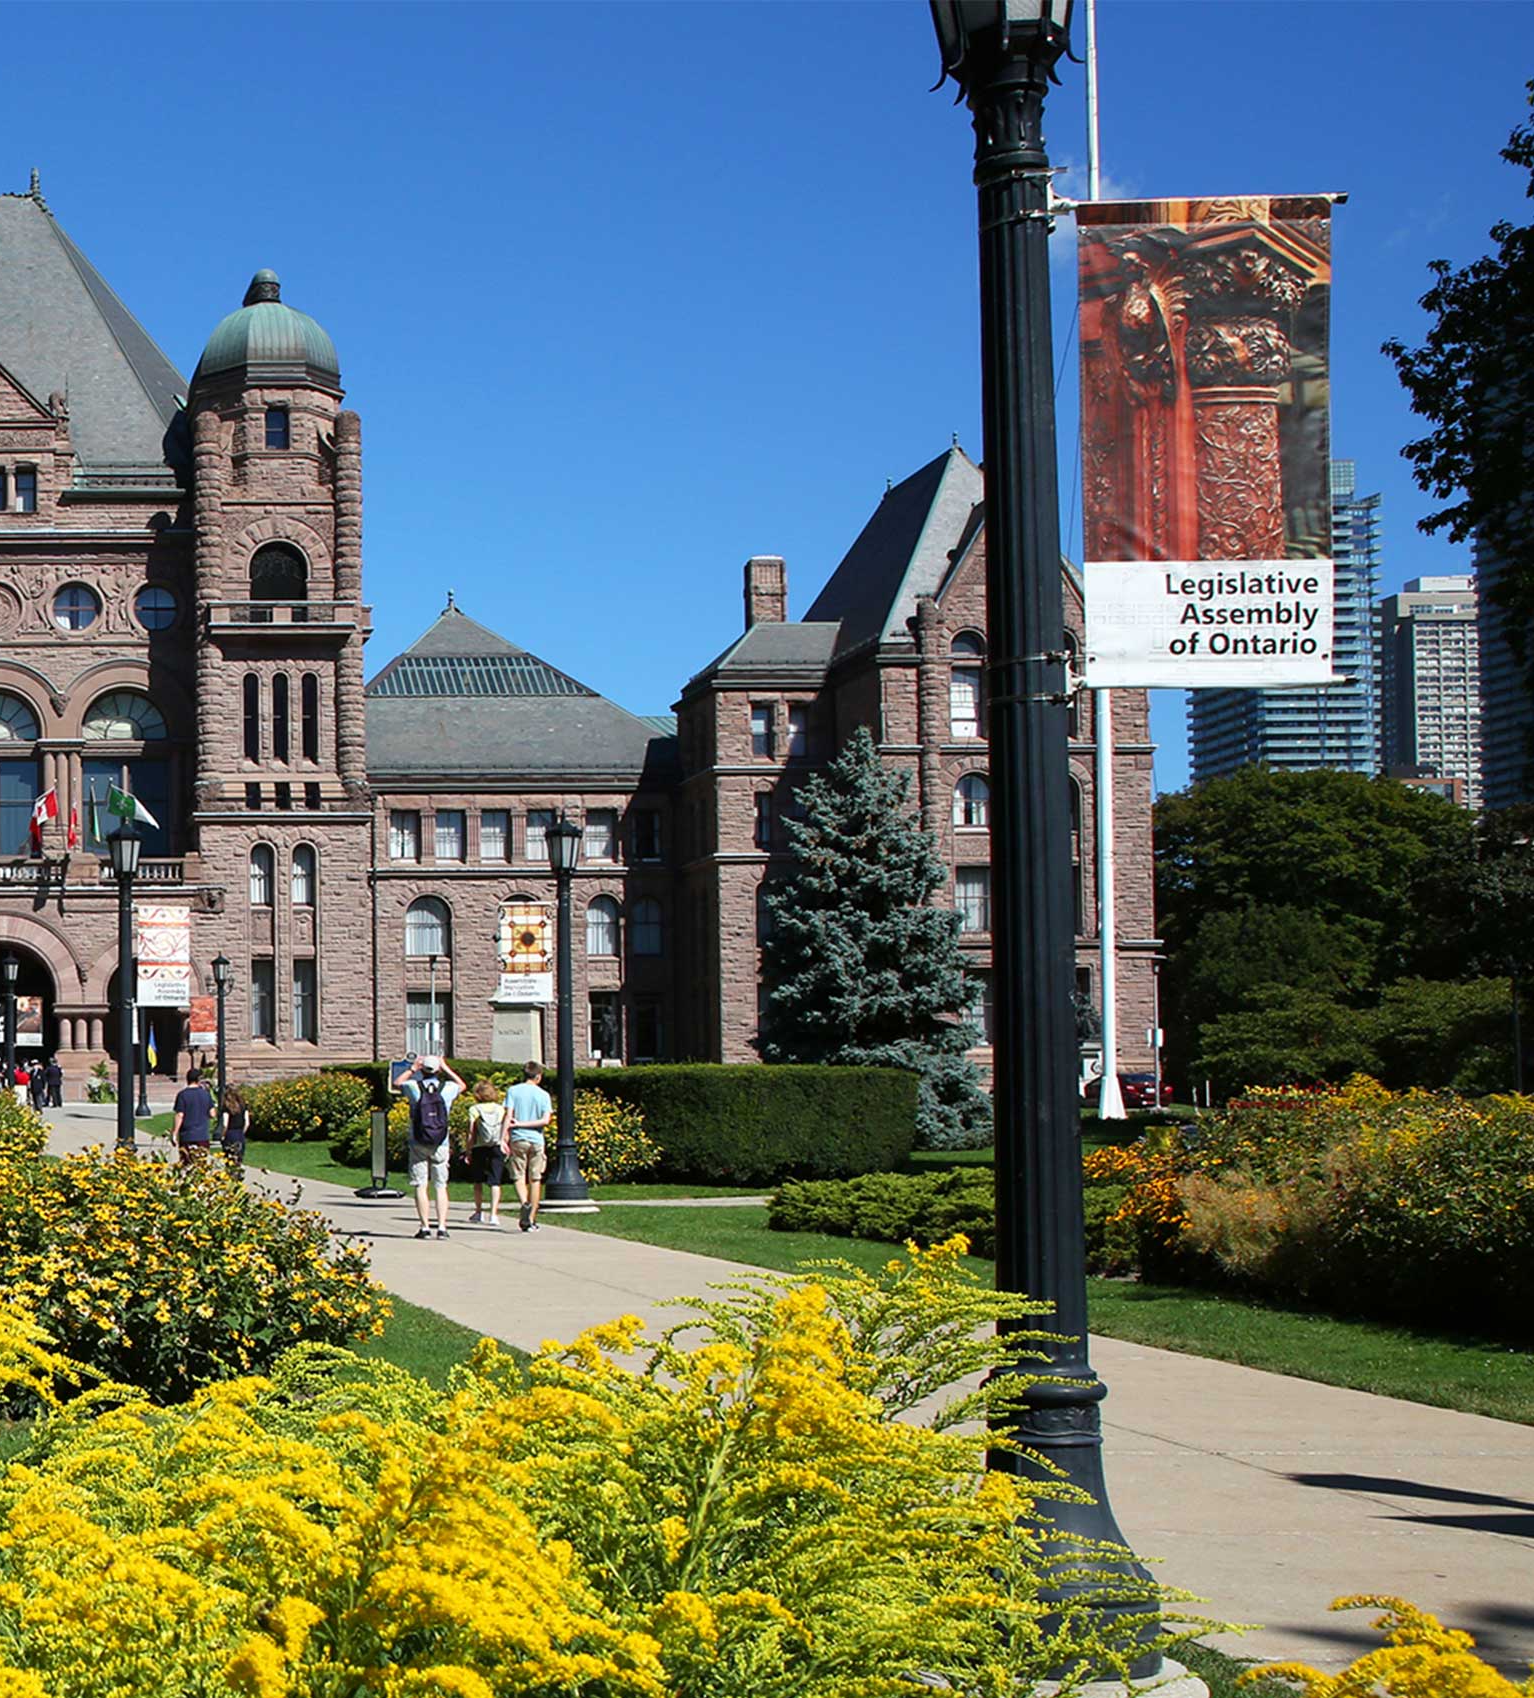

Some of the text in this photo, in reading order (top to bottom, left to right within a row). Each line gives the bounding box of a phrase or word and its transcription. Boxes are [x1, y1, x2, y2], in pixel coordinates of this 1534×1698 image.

[1165, 572, 1318, 600] Legislative
[1180, 601, 1319, 630] Assembly
[1169, 632, 1317, 655] of Ontario
